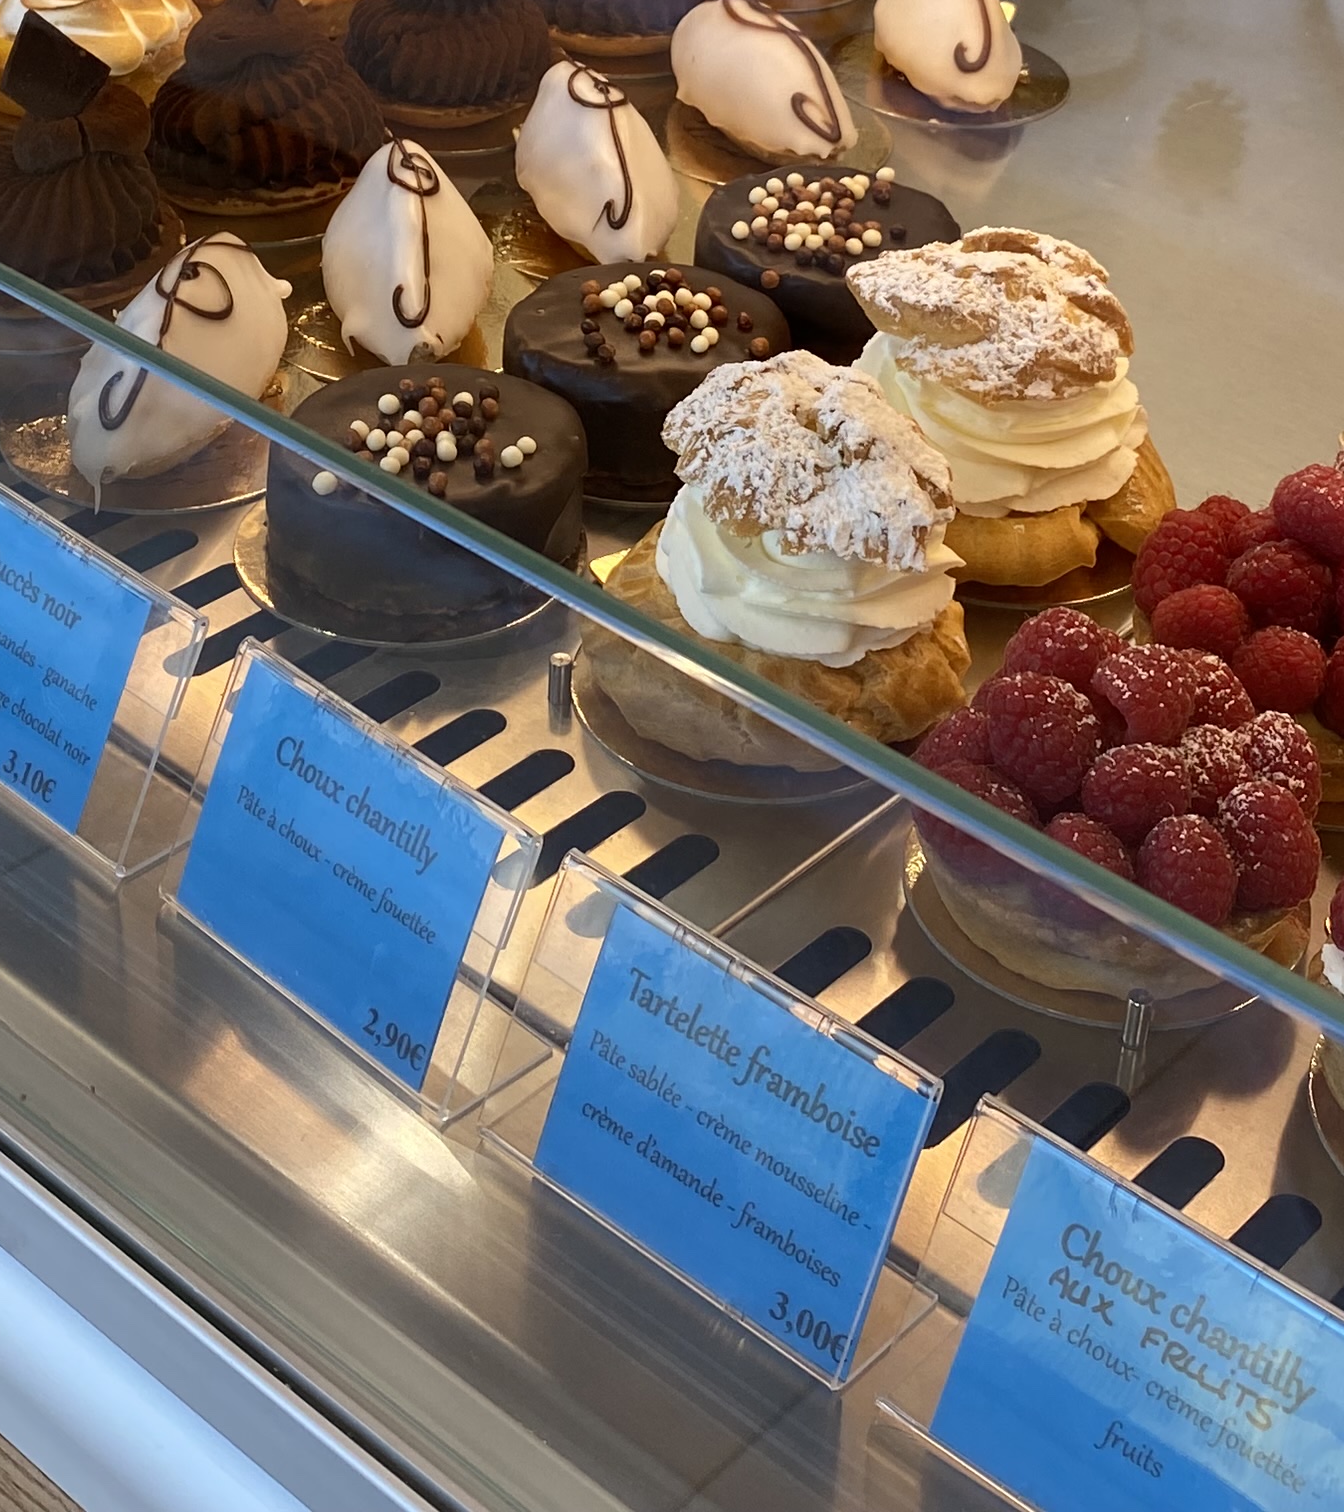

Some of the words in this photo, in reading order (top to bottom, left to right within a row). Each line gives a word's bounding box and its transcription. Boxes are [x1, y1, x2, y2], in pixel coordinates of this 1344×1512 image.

[42, 592, 82, 630] noir
[10, 697, 62, 748] chocolat
[63, 738, 92, 767] noir
[41, 666, 98, 713] ganache
[2, 749, 57, 804] 3,10€
[276, 736, 345, 805] Choux
[345, 786, 439, 876] chantilly
[236, 784, 267, 822] Pâte
[266, 806, 278, 831] à
[278, 816, 323, 863] choux
[332, 862, 378, 902] crème
[371, 887, 437, 946] fouettée
[362, 1007, 427, 1072] 2,90€
[627, 966, 742, 1068] Tartelette
[732, 1044, 882, 1159] framboise
[589, 1029, 627, 1072] Pâte
[628, 1060, 684, 1110] sablée
[696, 1107, 753, 1155] crème
[755, 1145, 862, 1228] mousseline
[581, 1100, 634, 1148] crème
[636, 1133, 725, 1209] d'amande
[729, 1201, 842, 1288] framboises
[768, 1291, 853, 1364] 3,00€
[1060, 1222, 1167, 1315] Choux
[1169, 1295, 1317, 1415] chantilly
[1002, 1274, 1047, 1322] Pâte
[1048, 1308, 1063, 1336] à
[1144, 1380, 1212, 1434] crème
[1210, 1418, 1308, 1496] fouettée
[1093, 1420, 1165, 1479] fruits
